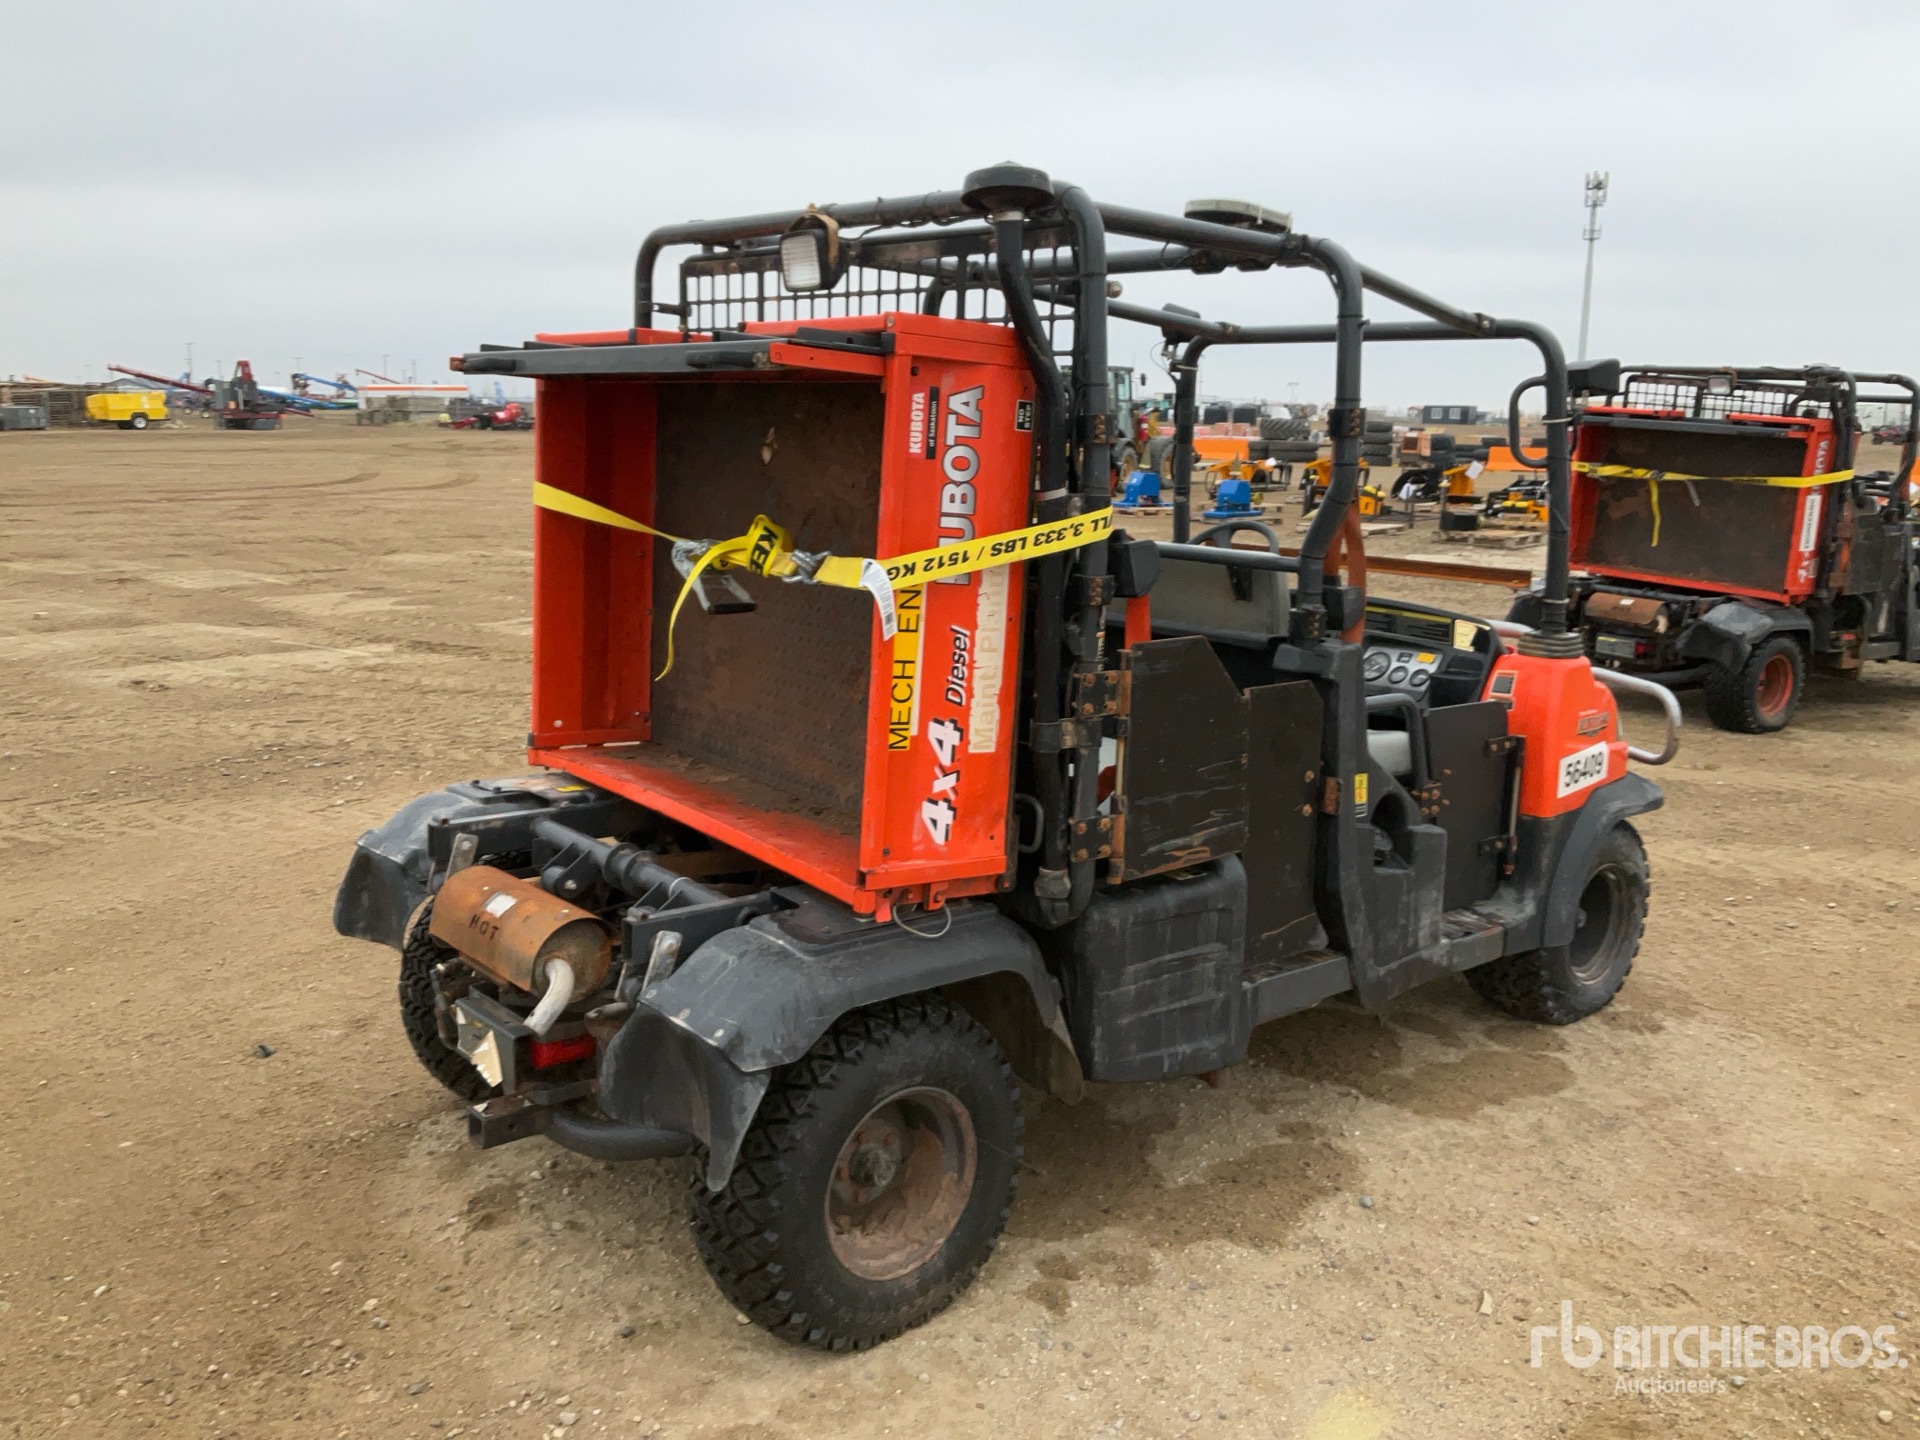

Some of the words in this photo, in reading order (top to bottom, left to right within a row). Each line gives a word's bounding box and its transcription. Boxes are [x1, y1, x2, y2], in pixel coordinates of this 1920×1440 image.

[909, 392, 925, 454] KUBOTA
[1017, 408, 1025, 423] NO
[990, 536, 1028, 557] LBS
[1033, 522, 1084, 547] 3,333
[922, 549, 970, 572] 1512
[976, 546, 985, 561] /
[887, 563, 916, 582] KG
[897, 584, 922, 633] EN
[945, 625, 970, 707] Diesel
[889, 660, 915, 750] MECH
[922, 717, 963, 846] 4x4
[1563, 751, 1604, 788] 56409
[470, 914, 500, 941] HOT
